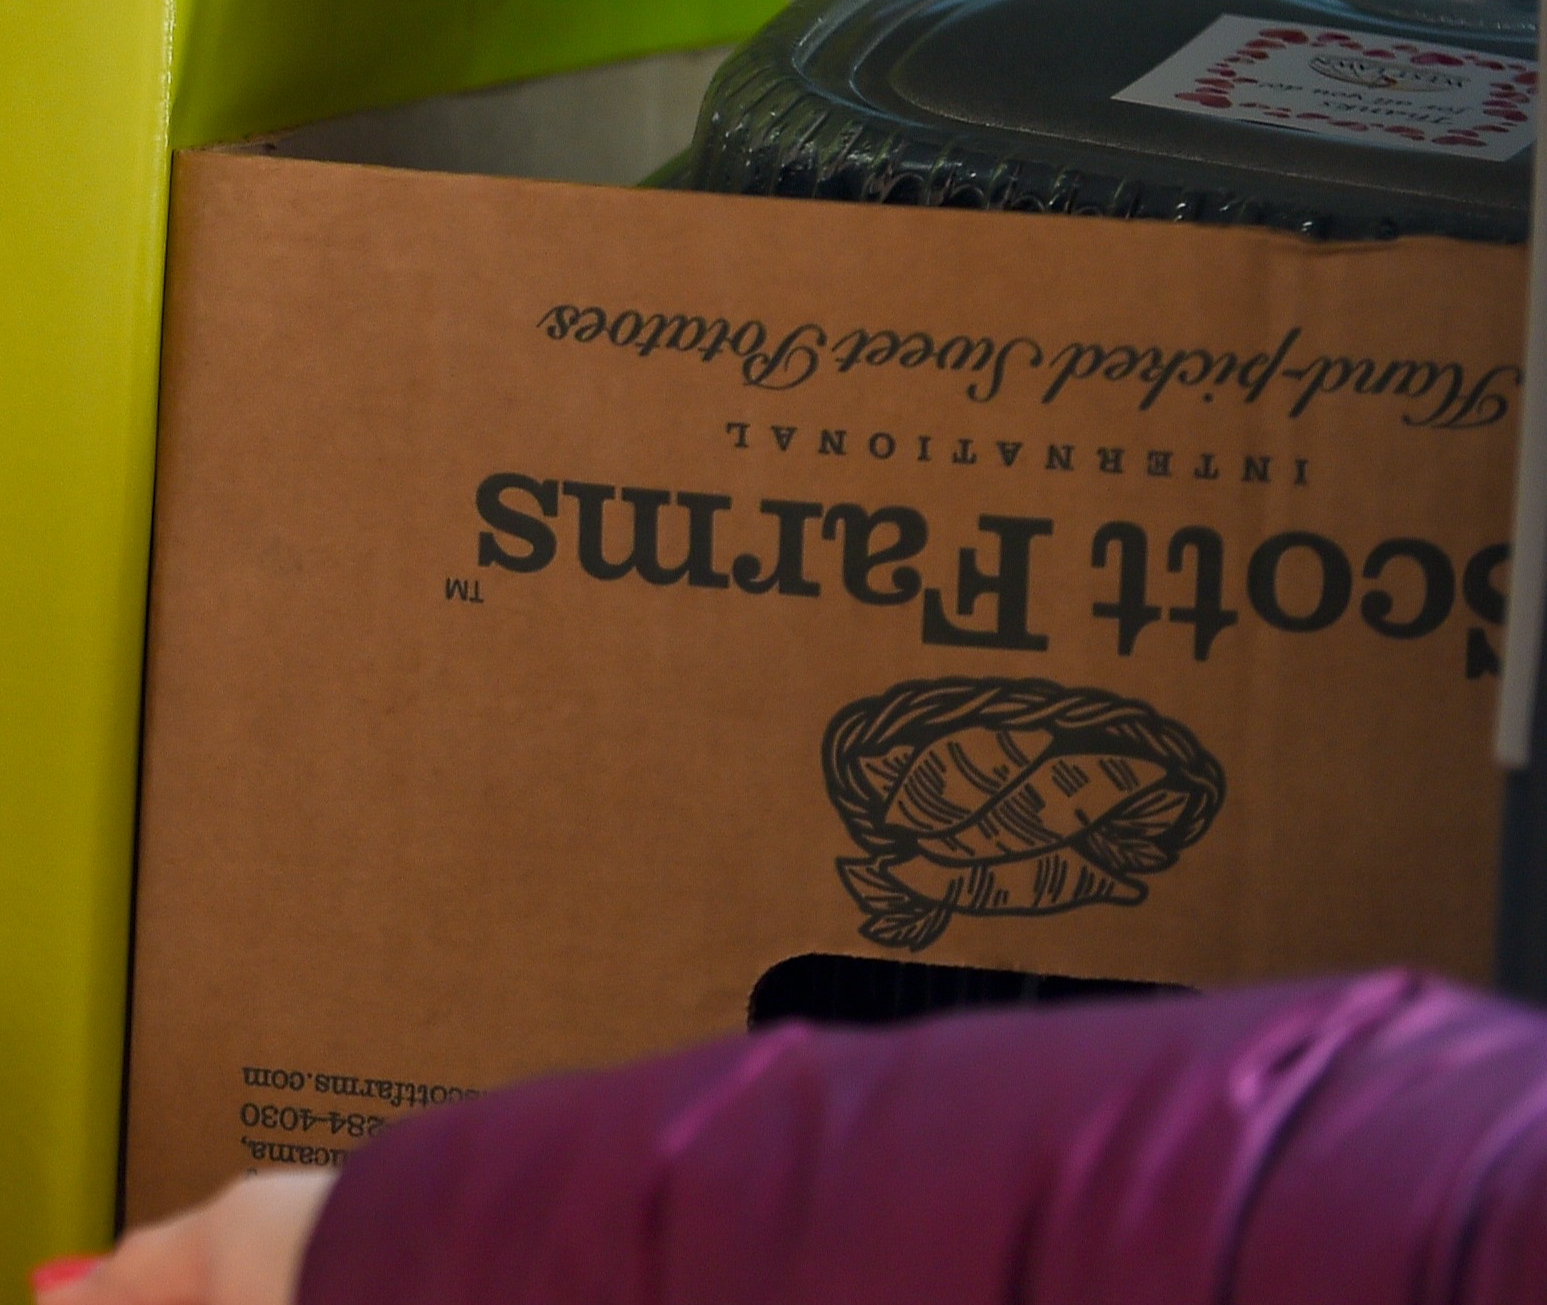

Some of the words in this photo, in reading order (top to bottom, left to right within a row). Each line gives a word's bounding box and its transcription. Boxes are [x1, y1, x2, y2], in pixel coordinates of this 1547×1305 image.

[534, 302, 827, 391] Potatoes
[829, 328, 1043, 403] Sweet
[1040, 324, 1522, 429] Hand-picked
[723, 420, 1309, 486] INTERNATIONAL
[474, 470, 1054, 652] Farms
